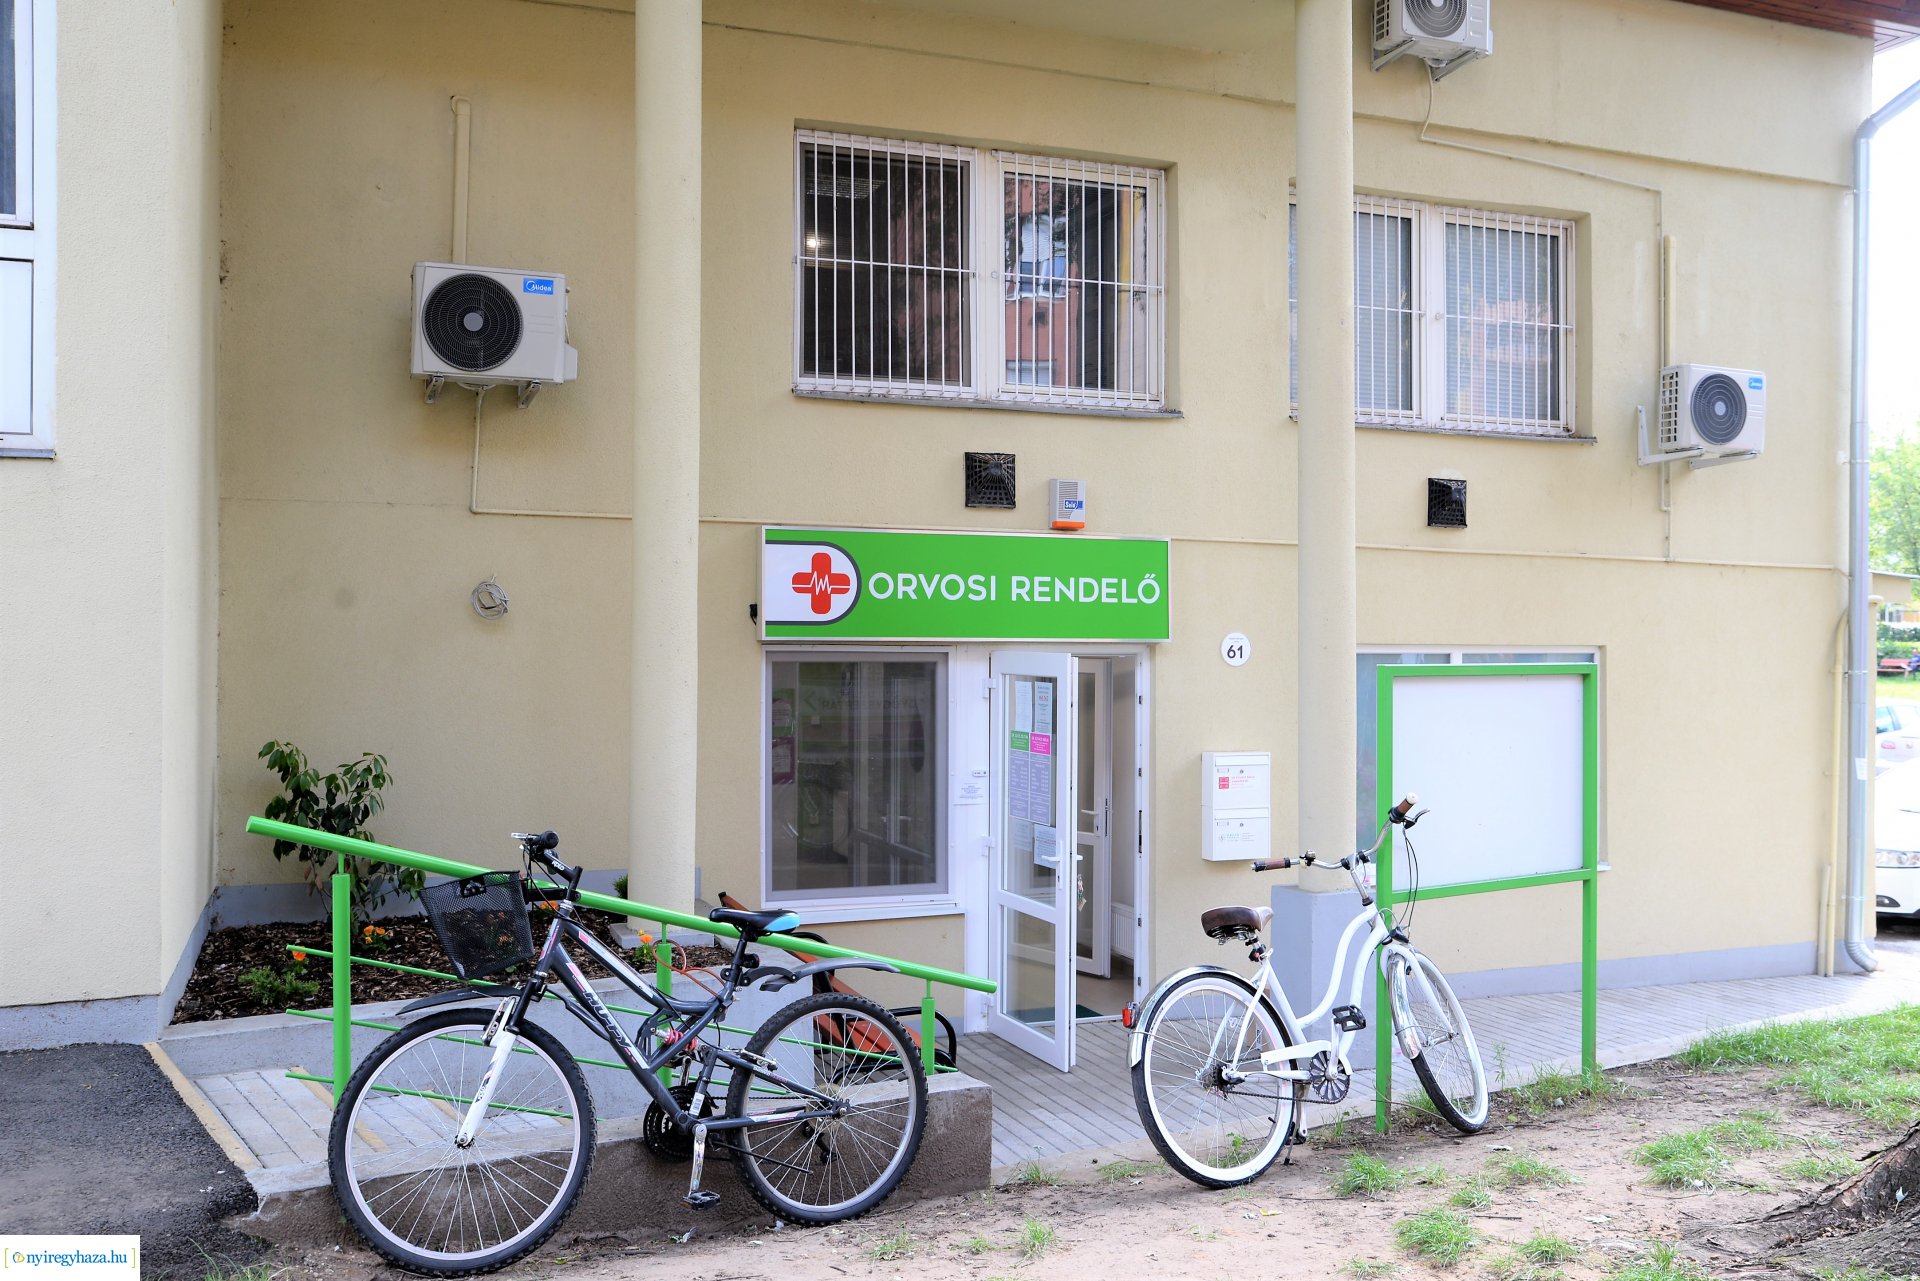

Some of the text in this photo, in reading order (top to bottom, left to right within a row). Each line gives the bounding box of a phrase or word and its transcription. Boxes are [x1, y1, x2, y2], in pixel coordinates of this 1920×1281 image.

[868, 572, 1161, 605] ORVOSI RENDELŐ
[1227, 644, 1243, 659] 61
